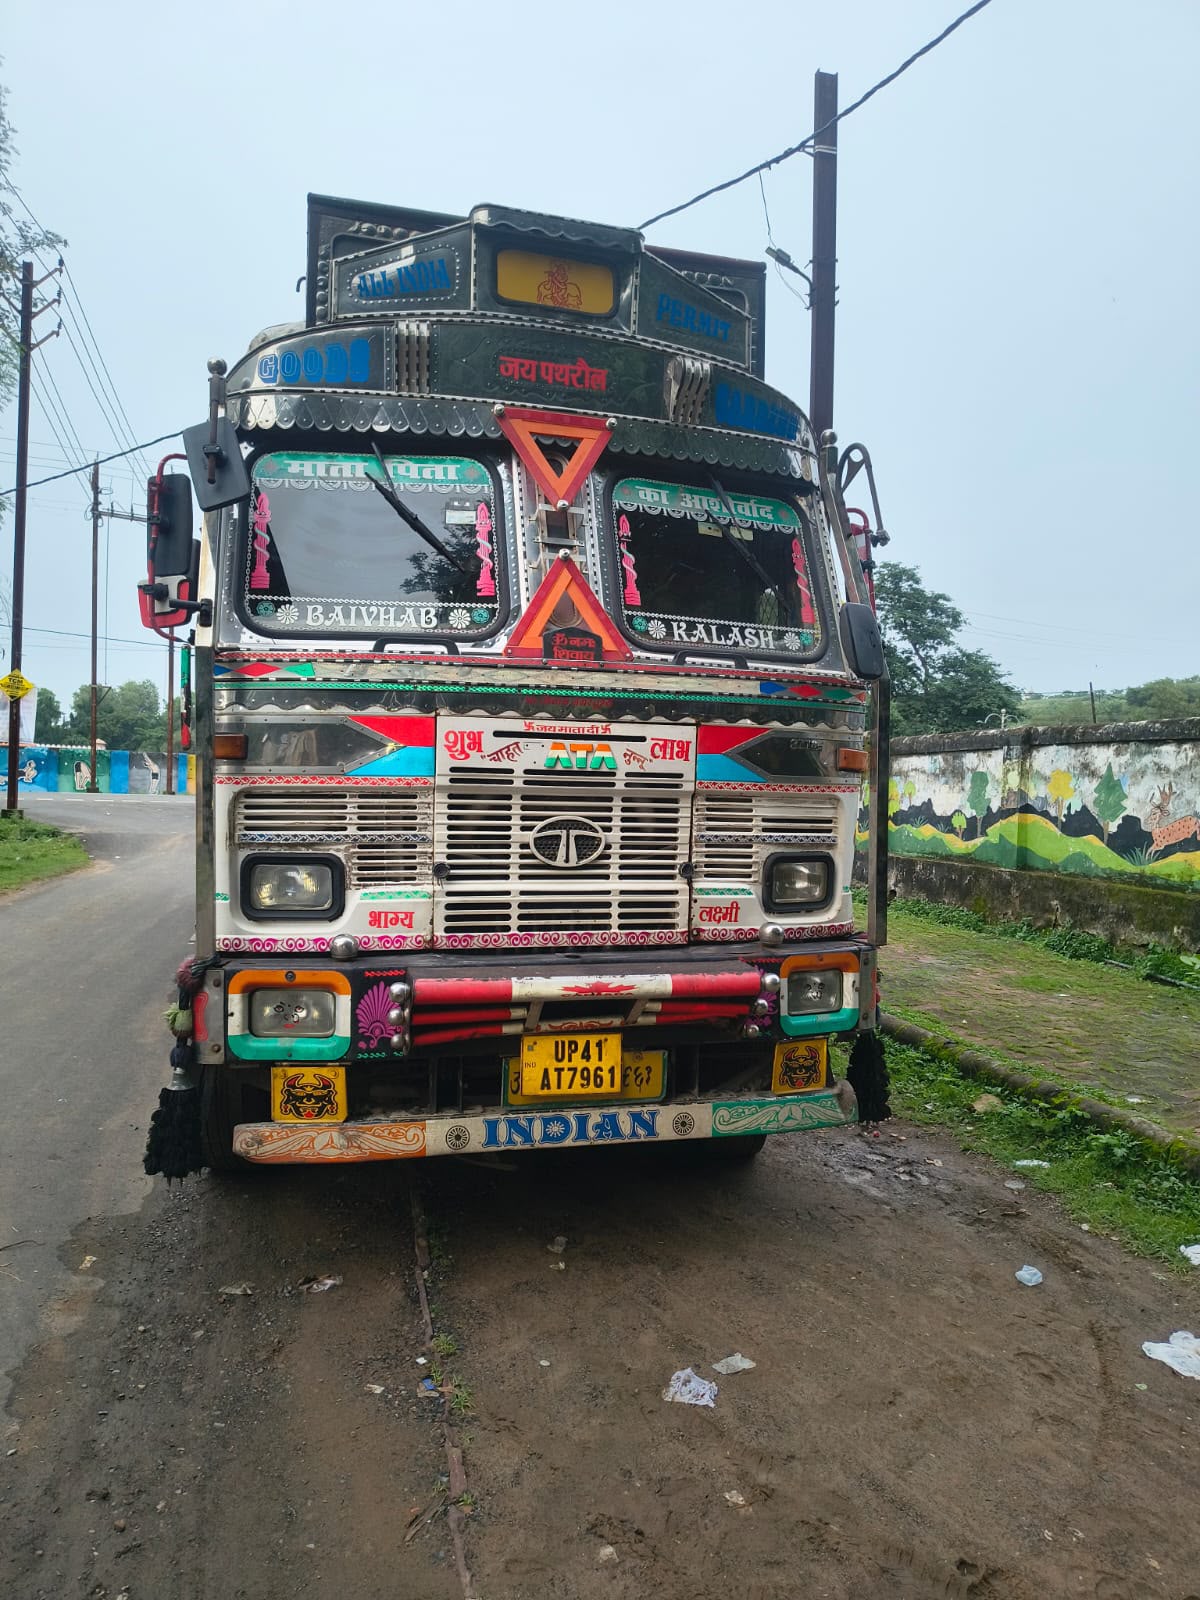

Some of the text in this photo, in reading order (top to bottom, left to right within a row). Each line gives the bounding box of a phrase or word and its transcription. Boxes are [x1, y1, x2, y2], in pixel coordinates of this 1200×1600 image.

[357, 258, 451, 299] ALL INDIA
[656, 292, 731, 342] PERMIT
[498, 355, 538, 383] जय
[284, 459, 369, 478] माता
[634, 485, 670, 505] का
[306, 604, 438, 629] BAIVHAB
[671, 620, 776, 650] KALASH
[536, 724, 600, 735] जय माता दी
[443, 729, 484, 761] शुभ
[544, 741, 617, 770] ATA
[650, 737, 692, 762] लाभ
[368, 910, 415, 929] भाग्य
[699, 900, 741, 924] लक्ष्मी
[482, 1109, 660, 1149] INDIAN
